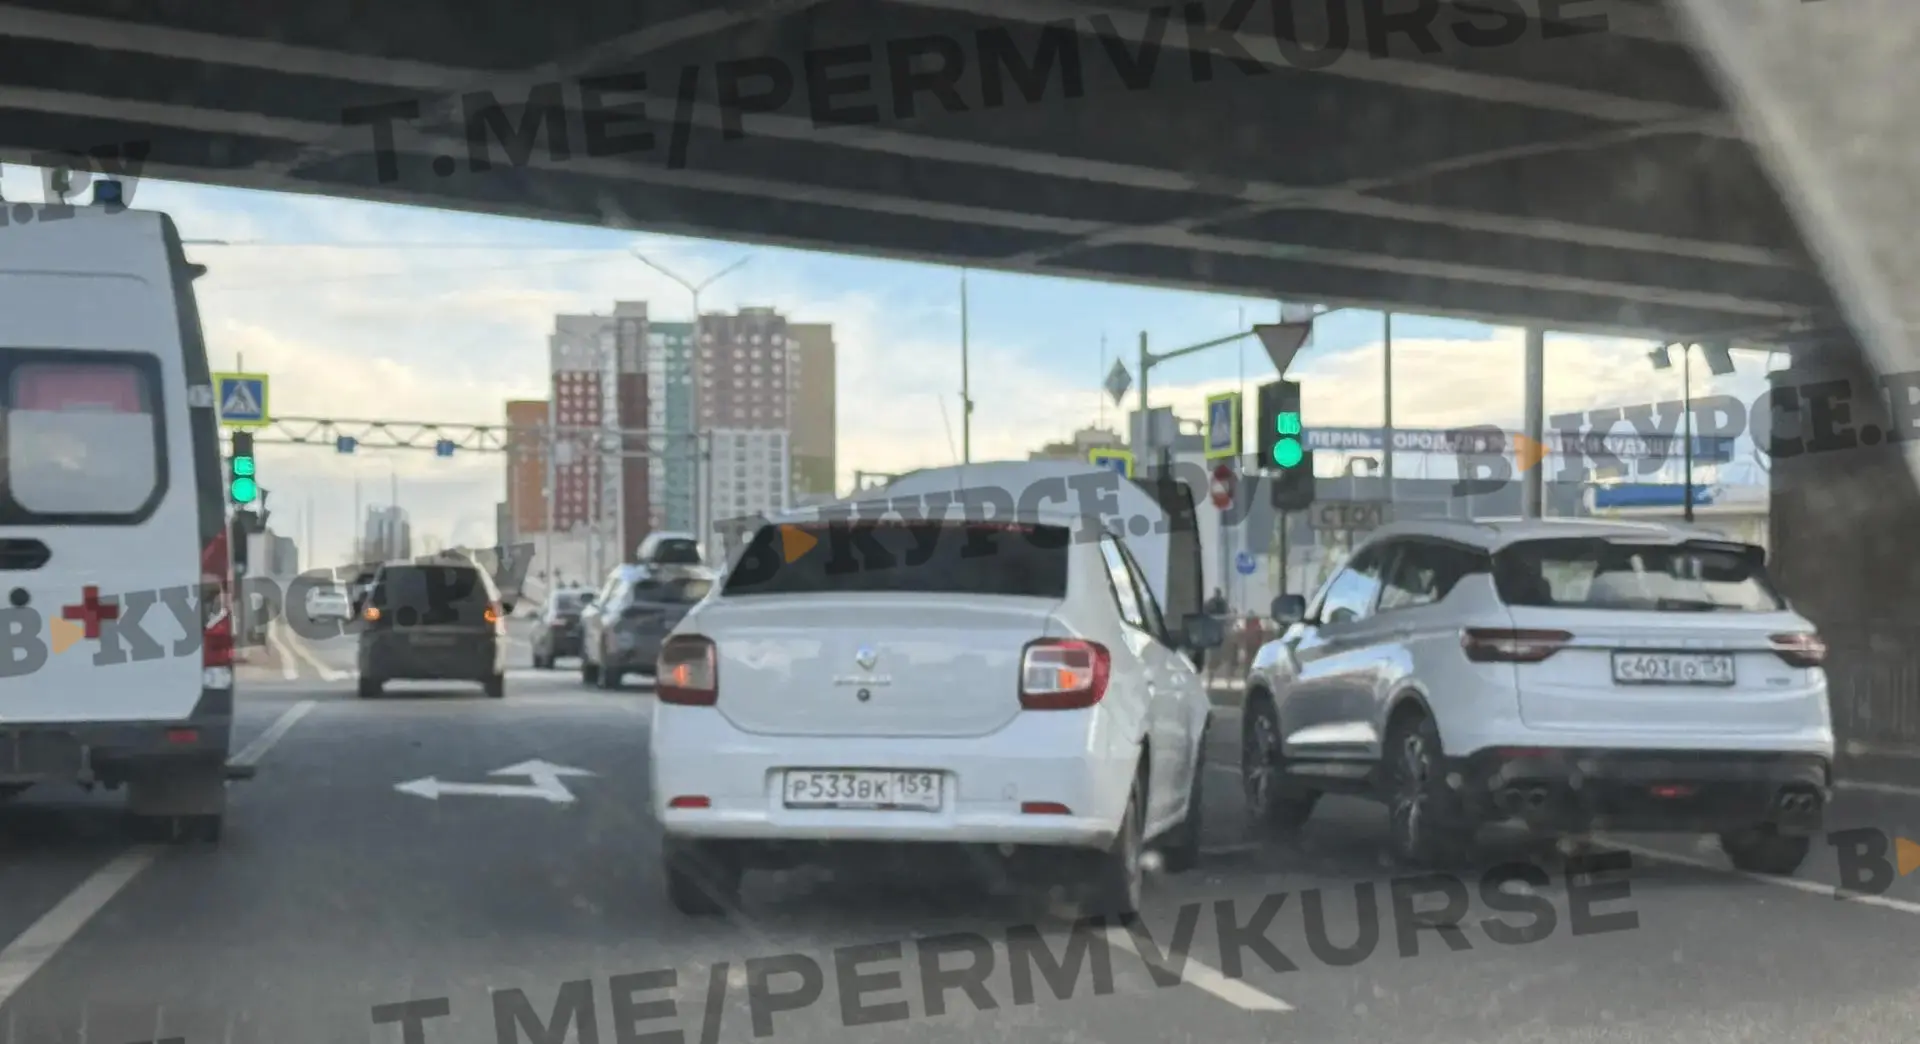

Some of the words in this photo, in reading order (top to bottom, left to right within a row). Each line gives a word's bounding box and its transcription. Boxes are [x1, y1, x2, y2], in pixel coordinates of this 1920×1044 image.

[1308, 430, 1370, 447] ПЕРМЬ
[792, 774, 887, 799] Р533ВК
[897, 775, 933, 794] 159
